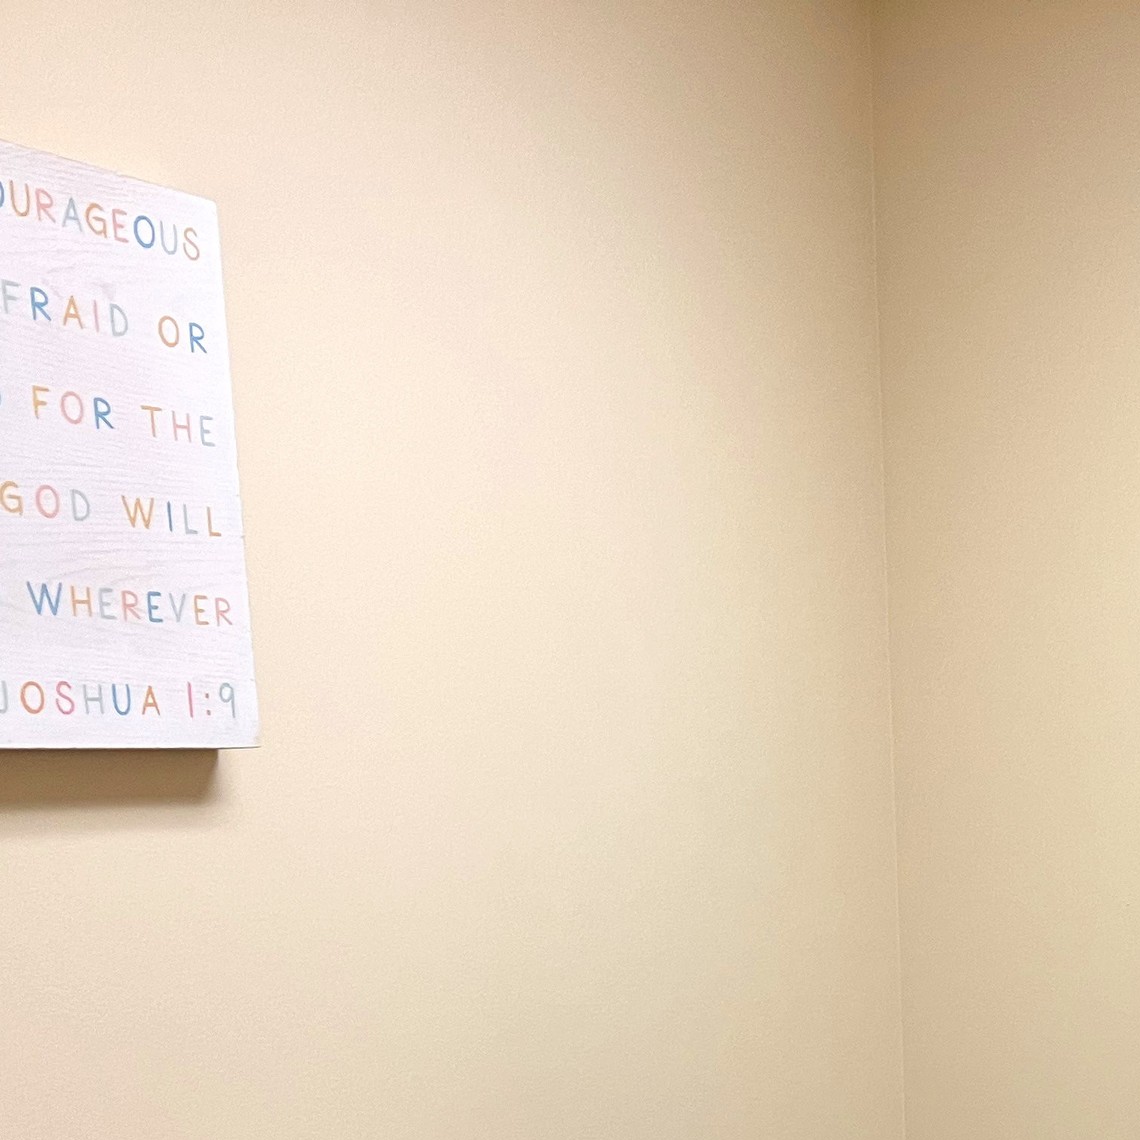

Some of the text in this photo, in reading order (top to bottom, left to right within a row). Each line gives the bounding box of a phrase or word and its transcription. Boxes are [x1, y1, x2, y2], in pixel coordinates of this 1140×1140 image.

[0, 179, 200, 261] URAGEOUS
[0, 278, 207, 354] FRAID OR
[31, 384, 216, 448] FOR THE
[0, 480, 222, 537] GOD WILL
[26, 580, 233, 627] WHEREVER
[0, 680, 236, 719] JOSHUA 1:9
